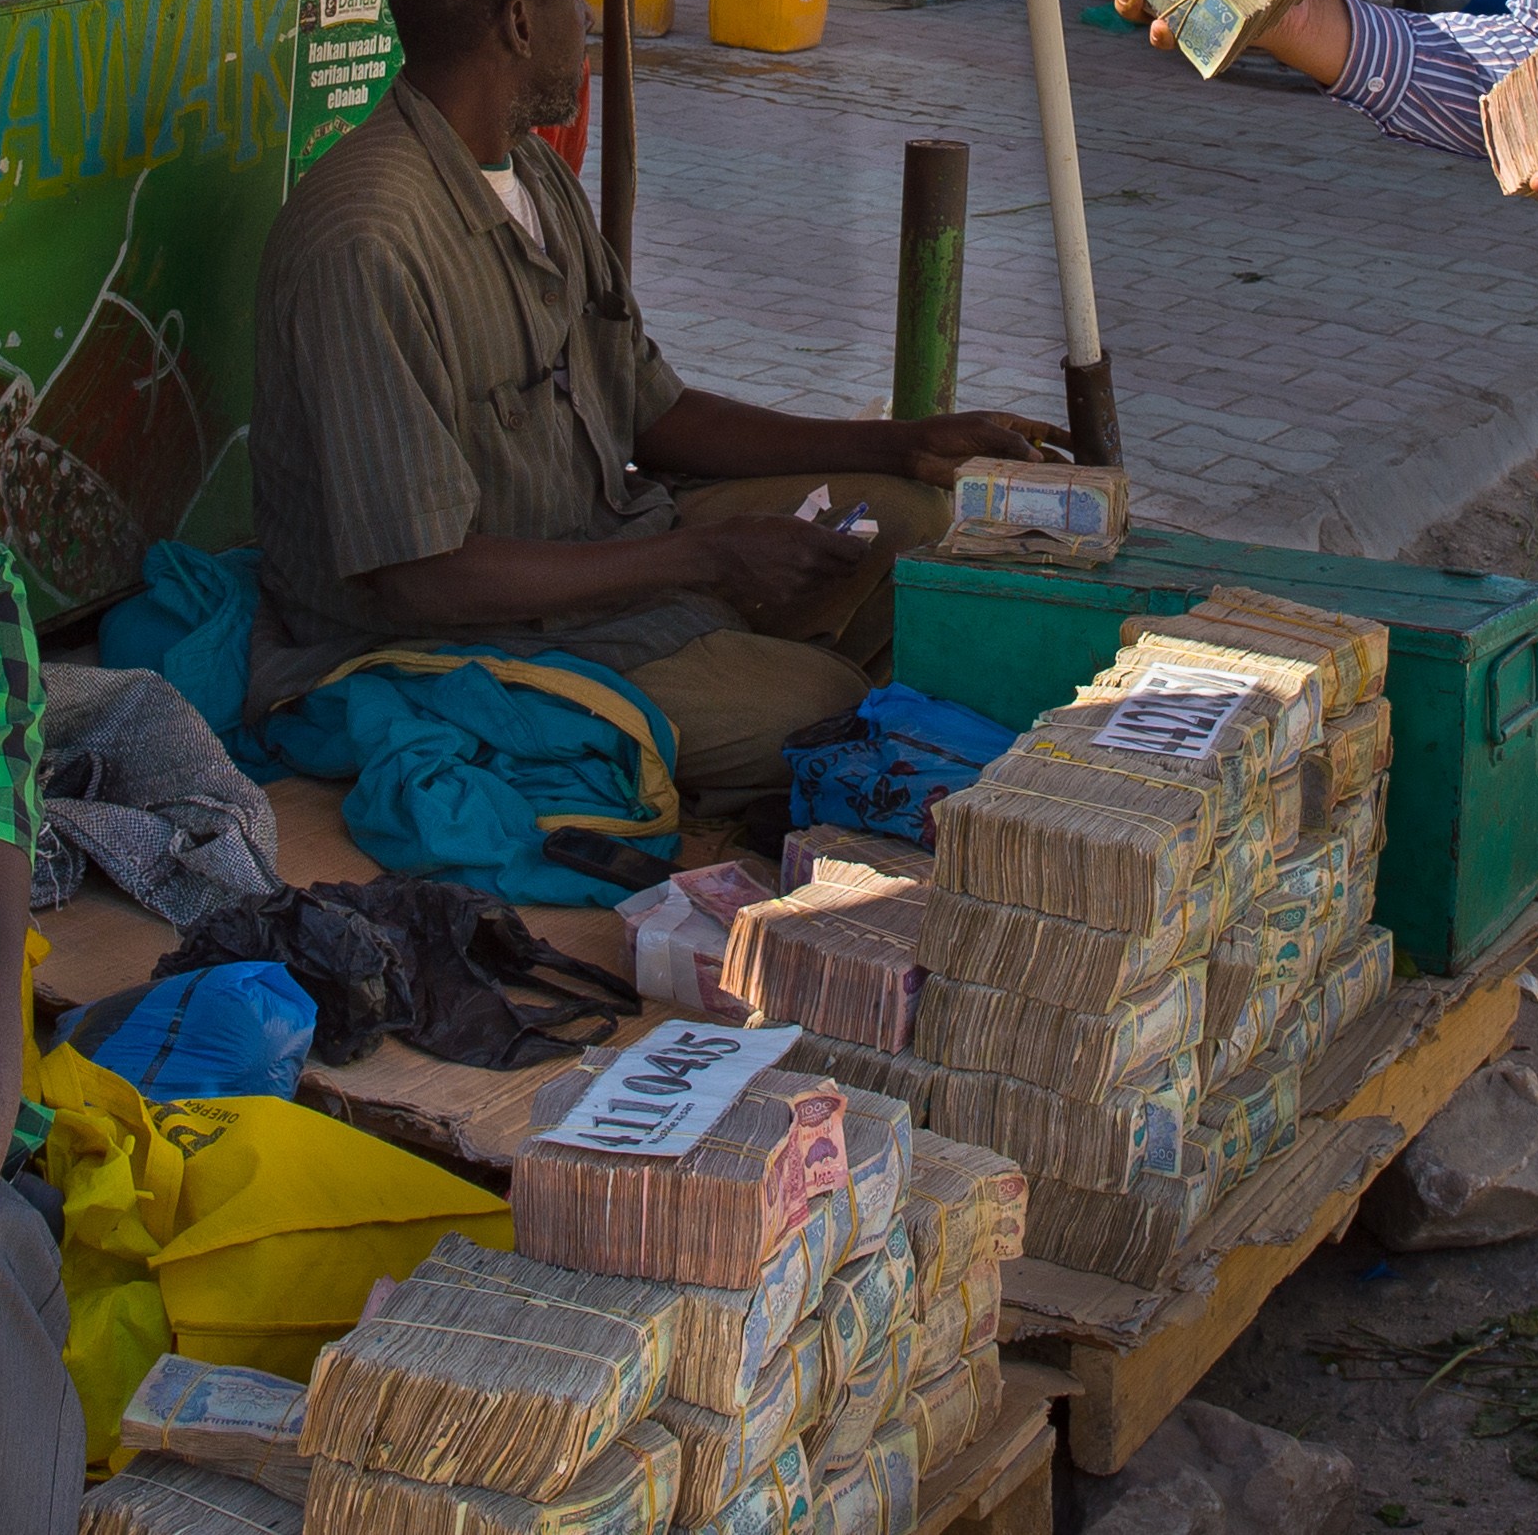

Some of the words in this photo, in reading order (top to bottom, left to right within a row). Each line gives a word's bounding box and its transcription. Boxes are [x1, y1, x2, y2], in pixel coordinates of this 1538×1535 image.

[308, 39, 348, 64] Halkan
[347, 36, 377, 60] waad
[377, 33, 392, 54] ka
[310, 64, 351, 89] sarifan
[350, 60, 387, 83] kartaa
[327, 84, 369, 110] eDahab
[576, 1031, 742, 1147] 4110435
[800, 1100, 833, 1117] 1000
